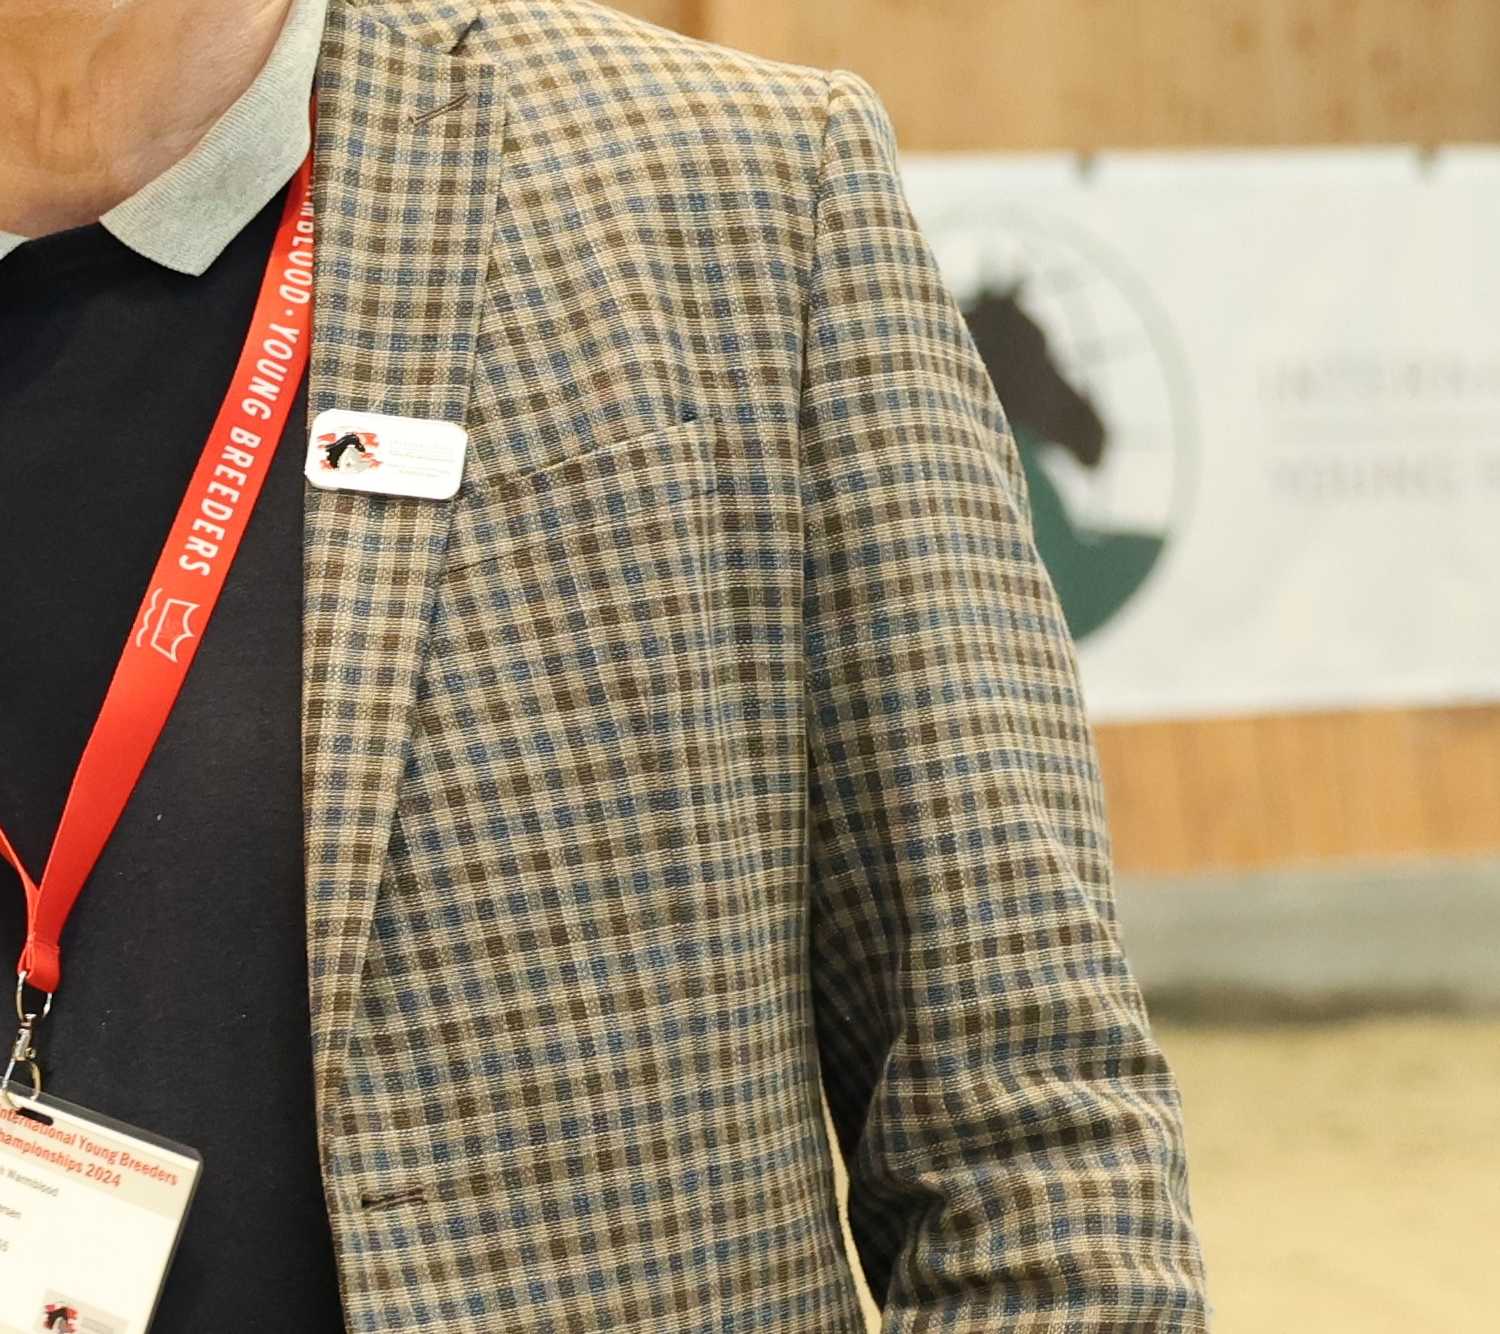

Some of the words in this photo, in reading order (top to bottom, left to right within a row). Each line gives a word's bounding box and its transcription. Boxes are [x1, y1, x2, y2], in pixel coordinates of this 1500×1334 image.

[241, 322, 300, 421] YOUNG
[178, 426, 261, 578] BREEDERS
[77, 1134, 117, 1165] Young
[119, 1151, 178, 1186] Breeders
[85, 1163, 122, 1188] 2024
